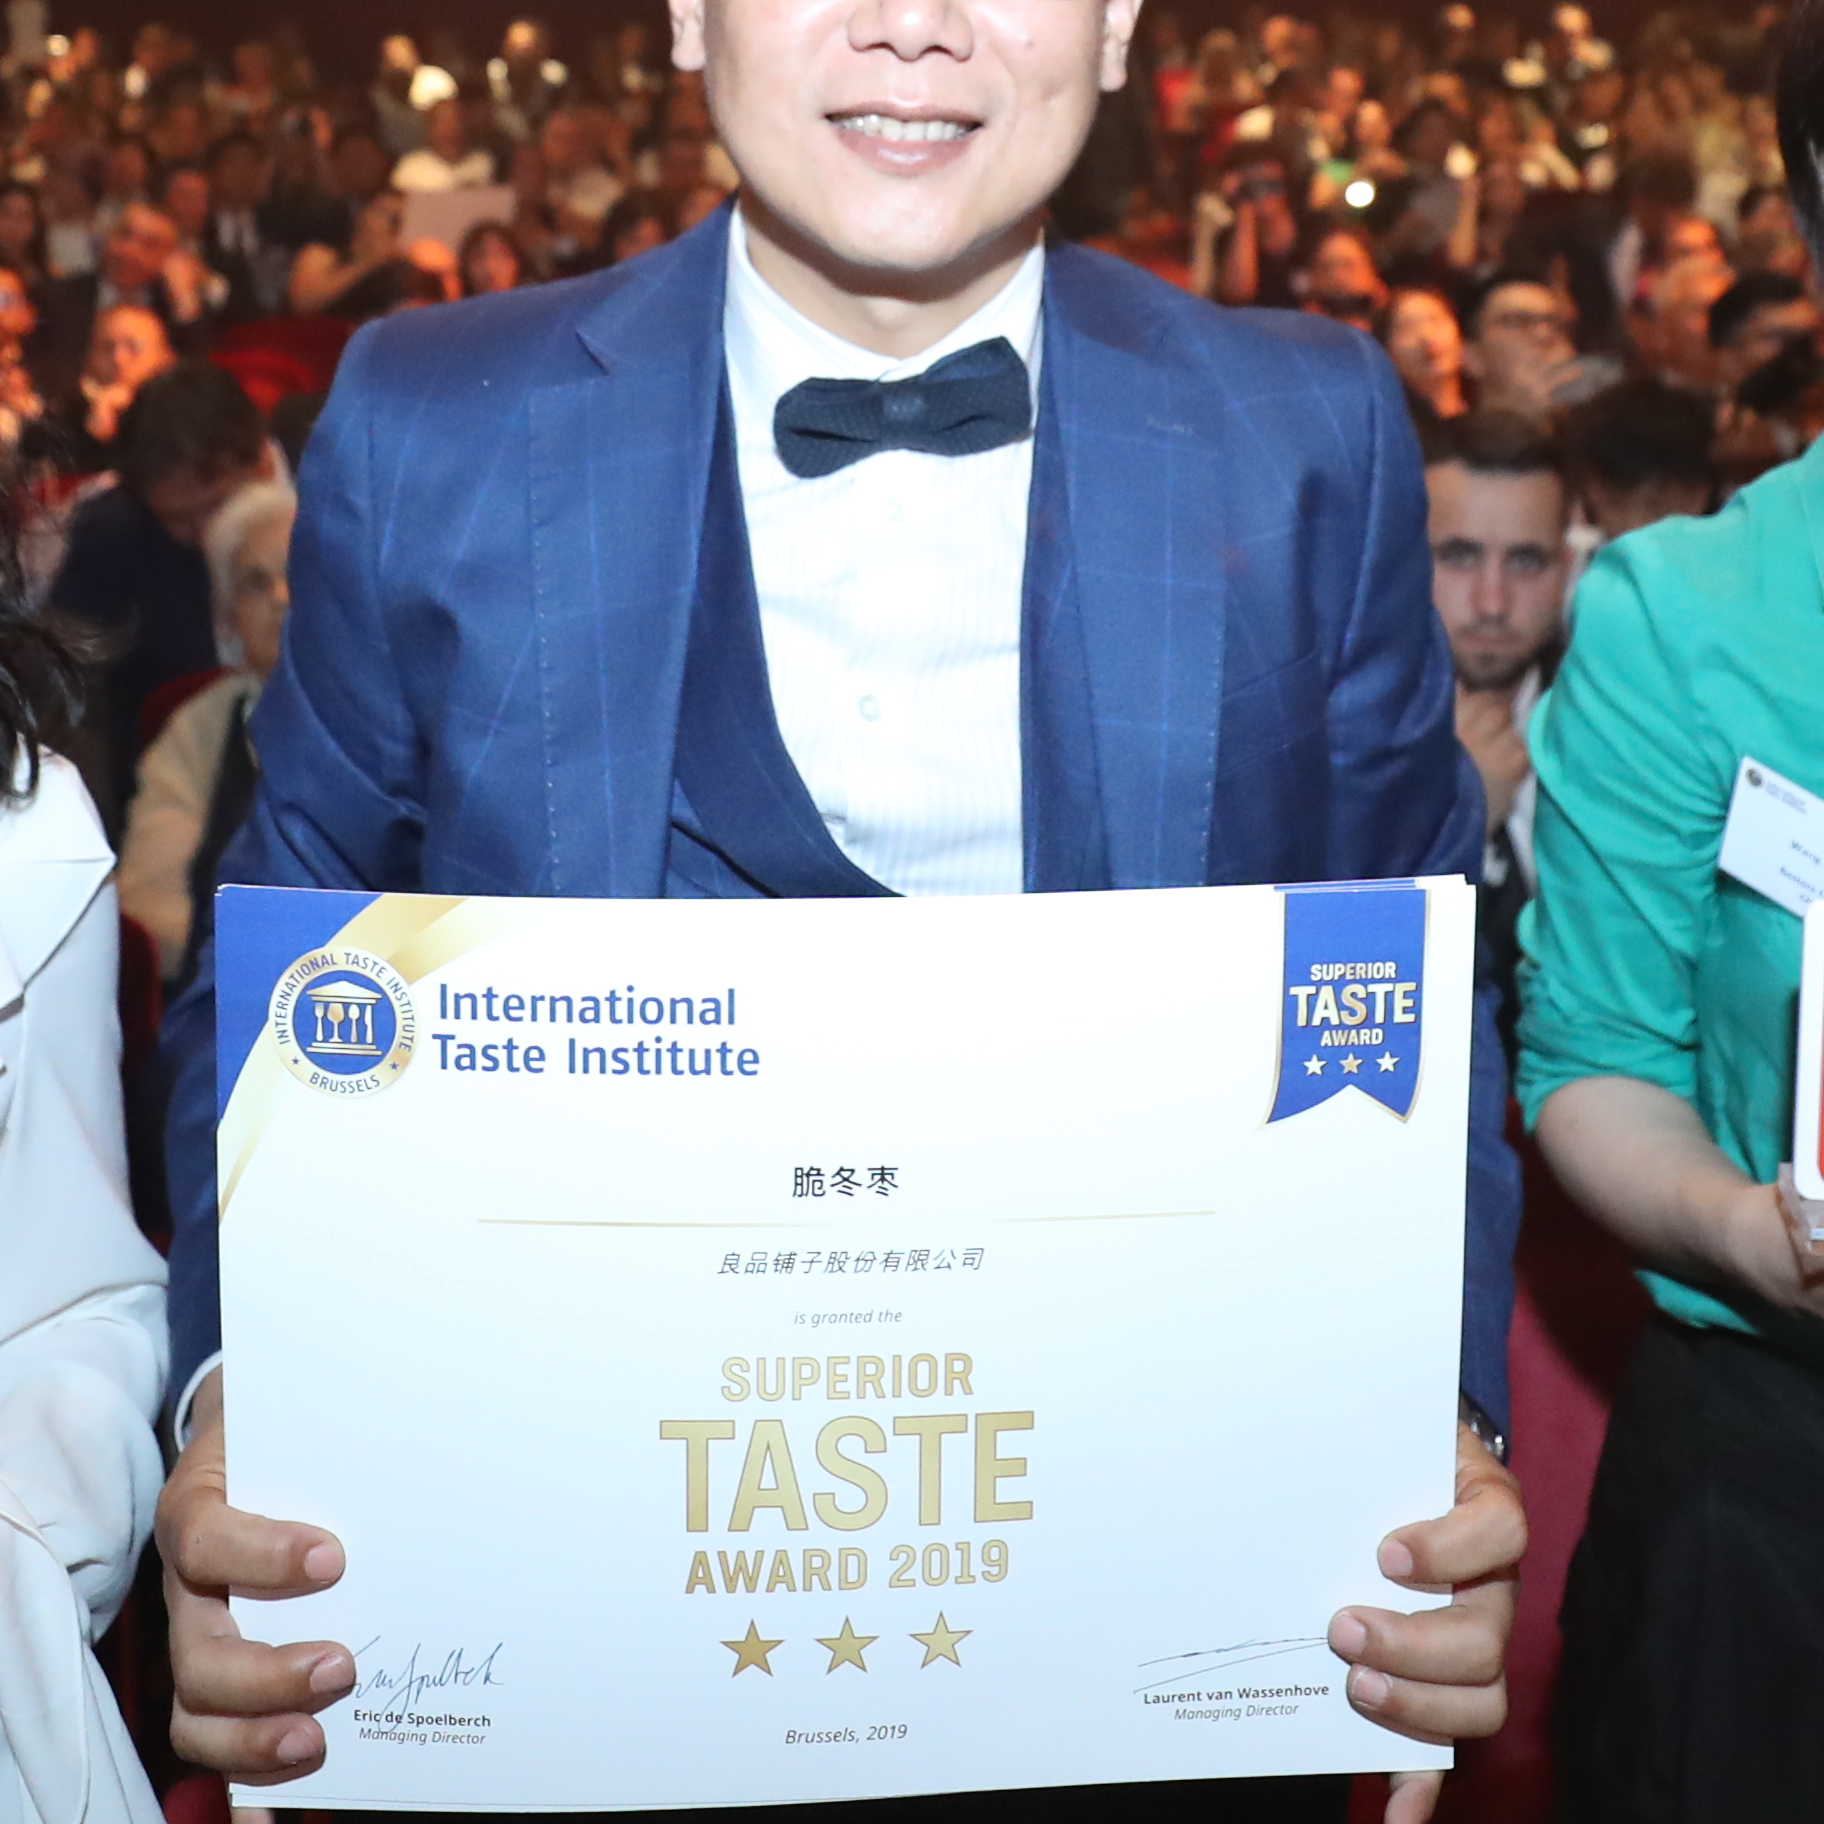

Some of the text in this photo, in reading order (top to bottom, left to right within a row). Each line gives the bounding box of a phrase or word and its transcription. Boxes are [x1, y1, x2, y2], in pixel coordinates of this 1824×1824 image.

[1310, 962, 1396, 981] SUPERIOR
[275, 952, 415, 1052] INTERNATIONAL TASTE INSTITUTE
[440, 983, 736, 1026] International
[1289, 982, 1417, 1027] TASTE
[1321, 1028, 1384, 1046] AWARD
[431, 1034, 760, 1076] Taste Institute
[310, 1072, 380, 1093] BRUSSELS
[792, 1165, 899, 1198] 脆冬枣
[717, 1246, 985, 1276] 良品铺子股份有限公司
[794, 1307, 903, 1328] is granted the
[720, 1352, 974, 1402] SUPERIOR
[659, 1410, 1035, 1532] TASTE
[685, 1539, 1009, 1594] AWARD 2019
[1144, 1684, 1329, 1704] Laurent van Wassenhove
[354, 1710, 491, 1727] Eric de Spoelberch
[1174, 1703, 1299, 1721] Managing Director
[359, 1728, 486, 1745] Managing Director
[784, 1724, 908, 1745] Brussels, 2019
